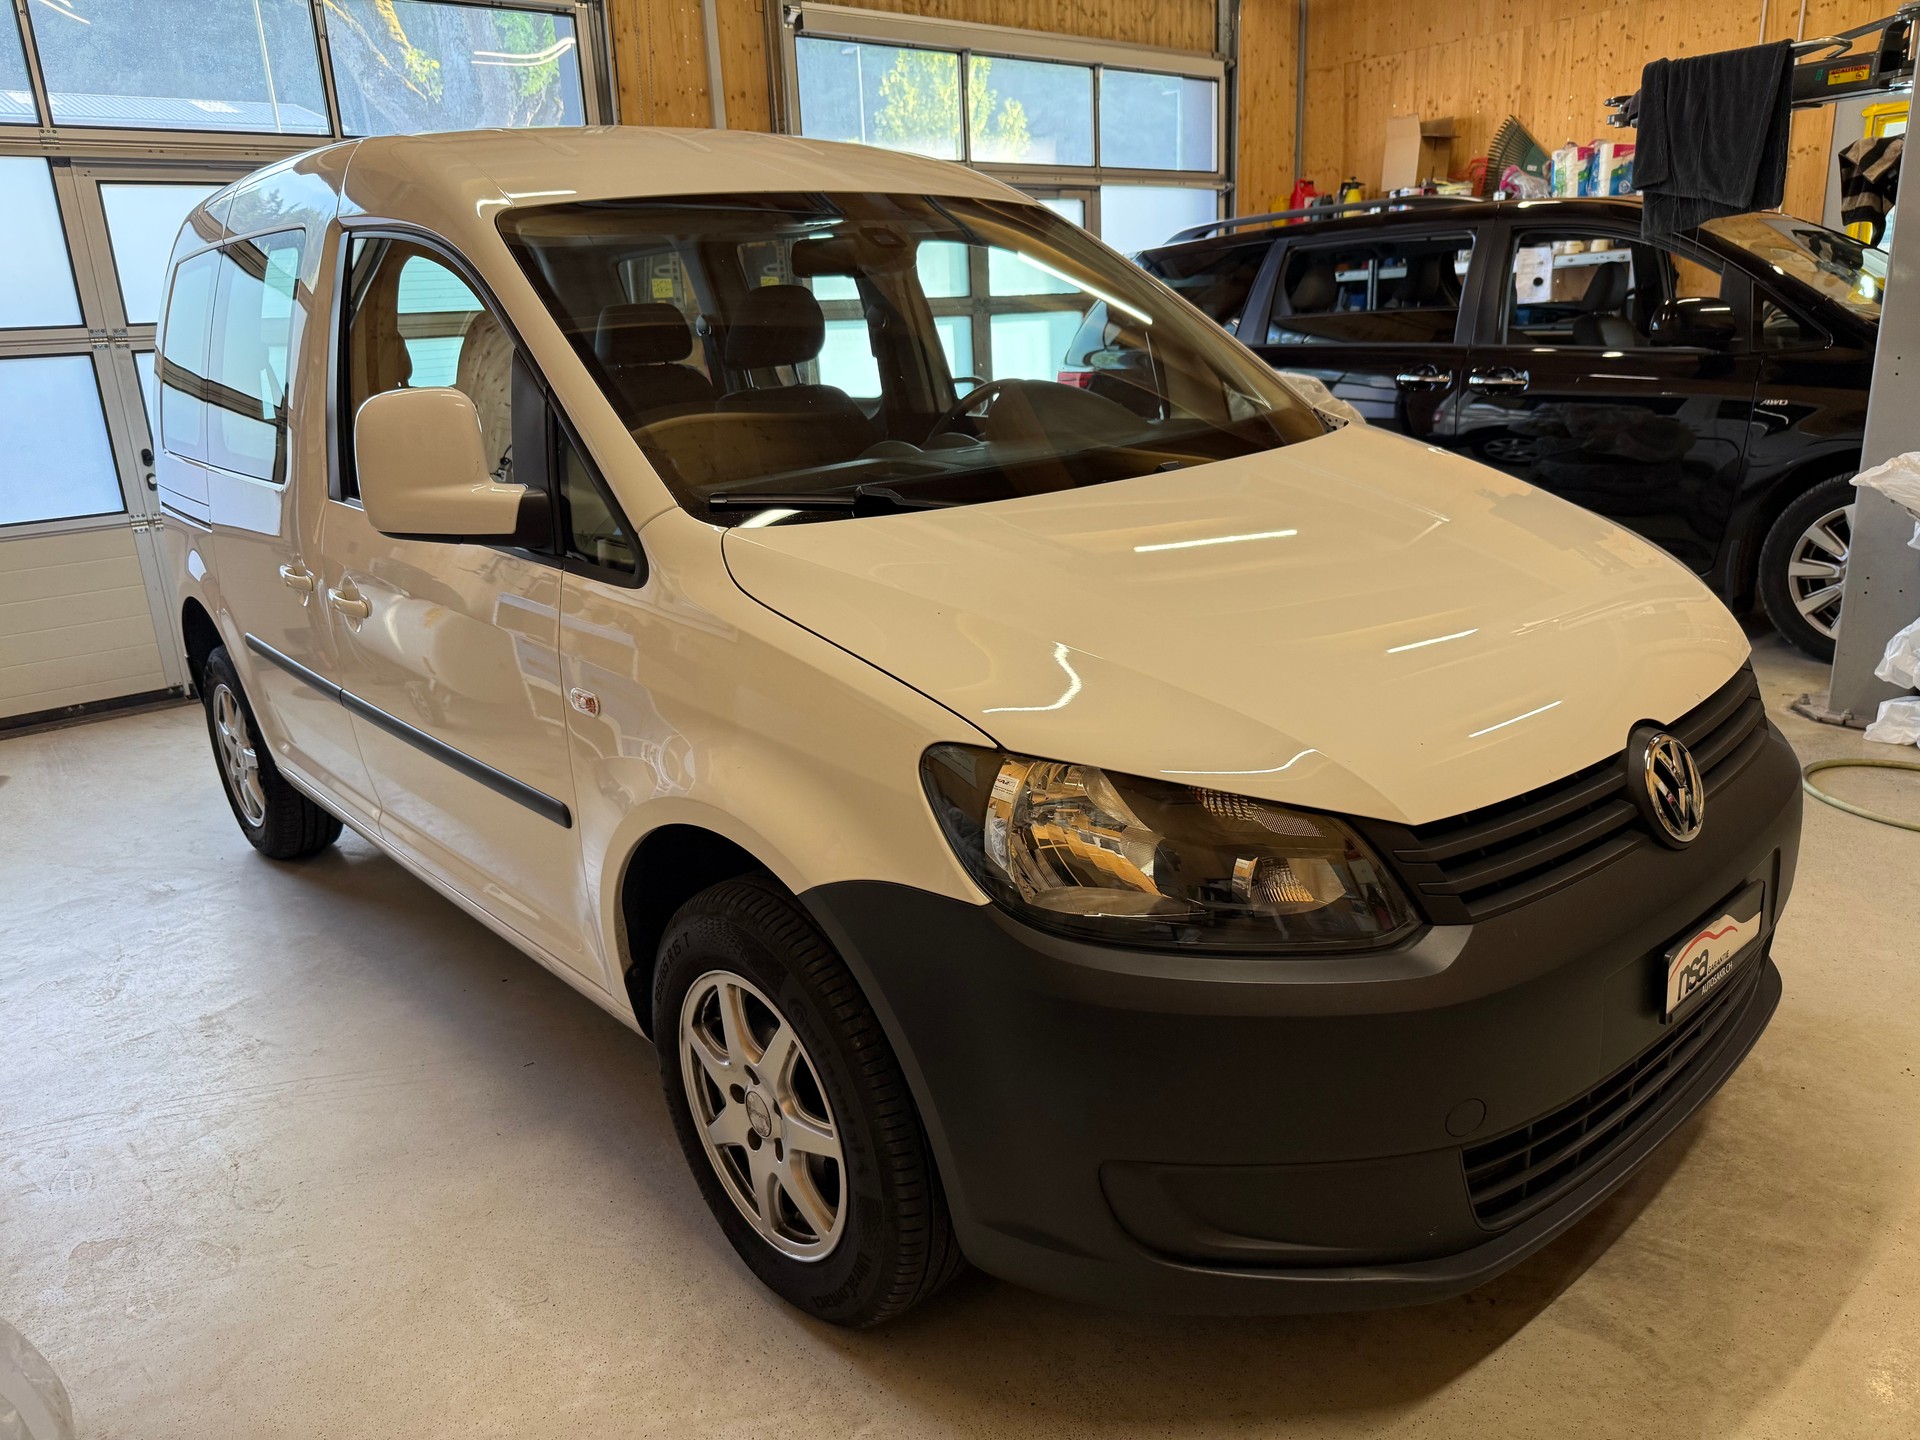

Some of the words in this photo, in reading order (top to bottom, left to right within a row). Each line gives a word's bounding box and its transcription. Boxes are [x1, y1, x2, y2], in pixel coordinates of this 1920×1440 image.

[1836, 65, 1867, 74] CAUTION
[1677, 949, 1709, 1001] nsa
[1708, 949, 1730, 974] GARANTIE
